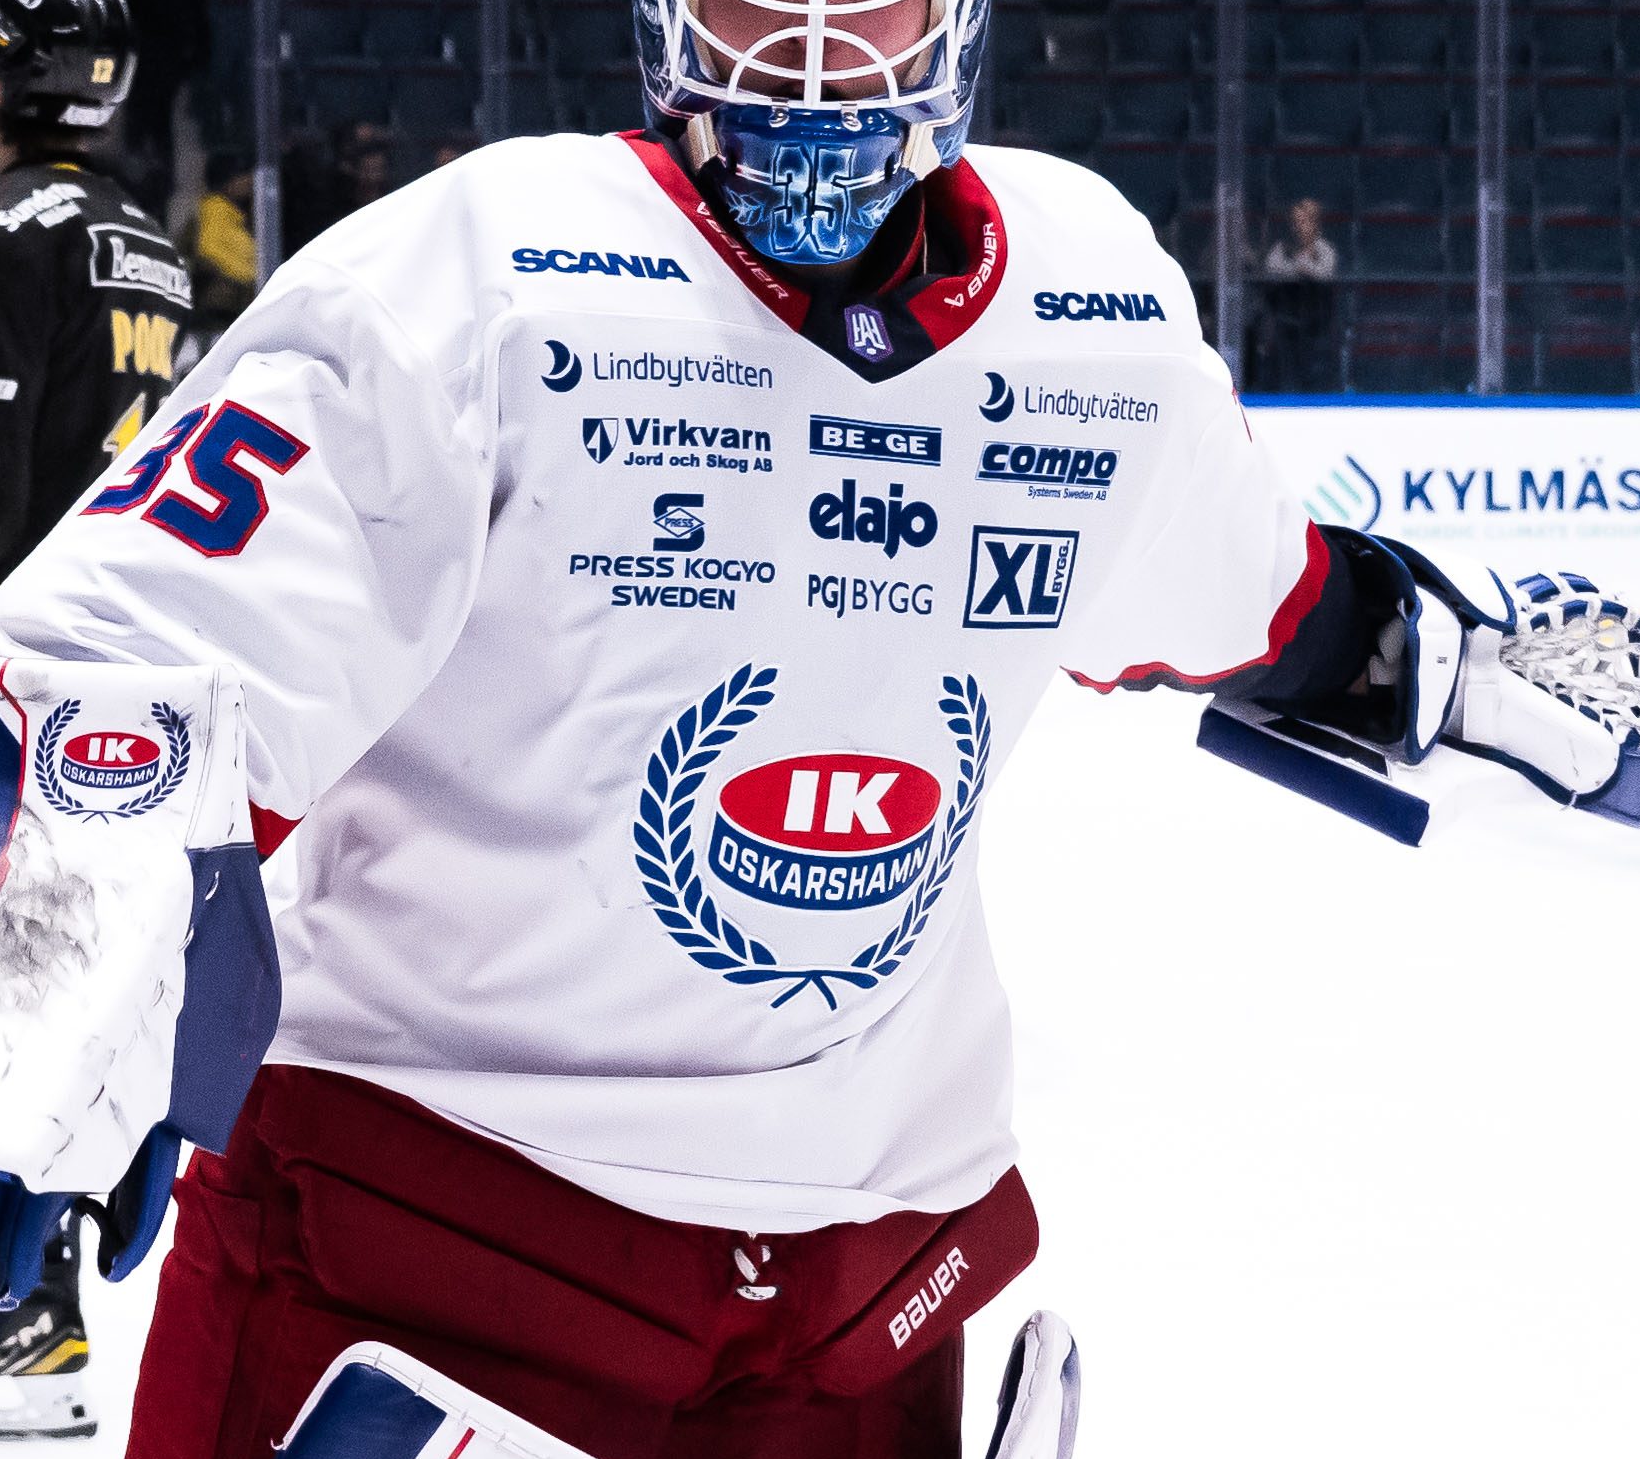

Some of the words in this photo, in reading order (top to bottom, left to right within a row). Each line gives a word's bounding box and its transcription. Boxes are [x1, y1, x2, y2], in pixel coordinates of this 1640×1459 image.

[511, 247, 692, 284] SCANIA
[967, 221, 998, 299] BAUER
[1032, 291, 1167, 322] SCANIA
[593, 352, 774, 389] Lindbytvätten
[1024, 386, 1159, 424] Lindbytvätten
[624, 417, 772, 452] Virkvarn
[77, 398, 311, 560] 35
[623, 452, 664, 467] Jord
[669, 453, 701, 468] och
[706, 454, 749, 474] Skog
[753, 458, 774, 472] AB
[980, 442, 1119, 485] compo
[1063, 487, 1094, 500] Sweden
[664, 518, 695, 529] PRESS
[808, 478, 939, 560] elajo
[569, 554, 674, 579] PRESS
[684, 557, 776, 584] KOGYO
[972, 541, 1055, 616] XL
[611, 585, 736, 611] SWEDEN
[852, 577, 934, 616] BYGG
[87, 737, 137, 763] IK
[63, 763, 156, 788] OSKARSHAMN
[782, 769, 902, 835] IK
[717, 834, 933, 902] OSKARSHAMN
[888, 1246, 970, 1350] BAUER
